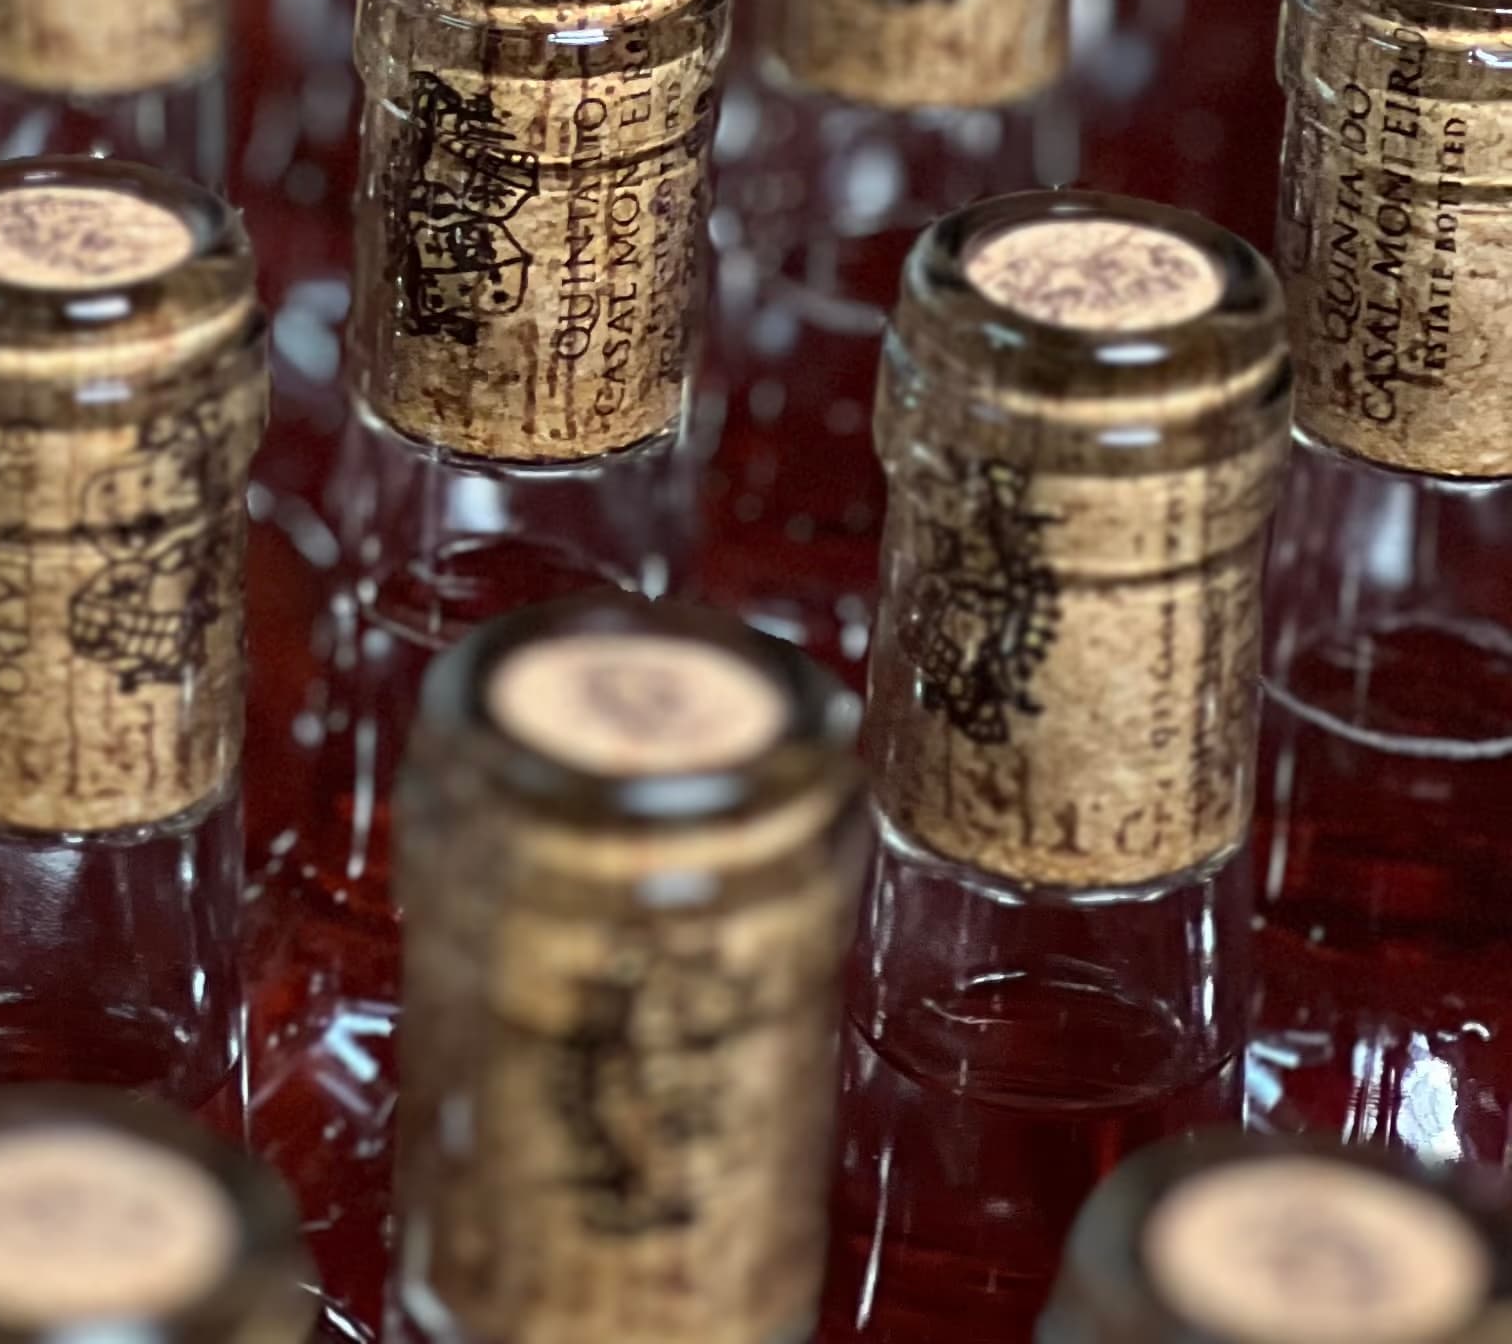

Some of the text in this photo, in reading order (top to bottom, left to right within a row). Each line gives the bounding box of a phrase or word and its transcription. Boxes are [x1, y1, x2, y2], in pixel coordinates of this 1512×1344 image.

[555, 180, 601, 360] QUINTA
[1317, 81, 1373, 346] QUINTA DO
[1359, 24, 1429, 426] CASAL MONTEIRO
[592, 283, 638, 417] CASAL
[1420, 267, 1455, 371] ESTATE
